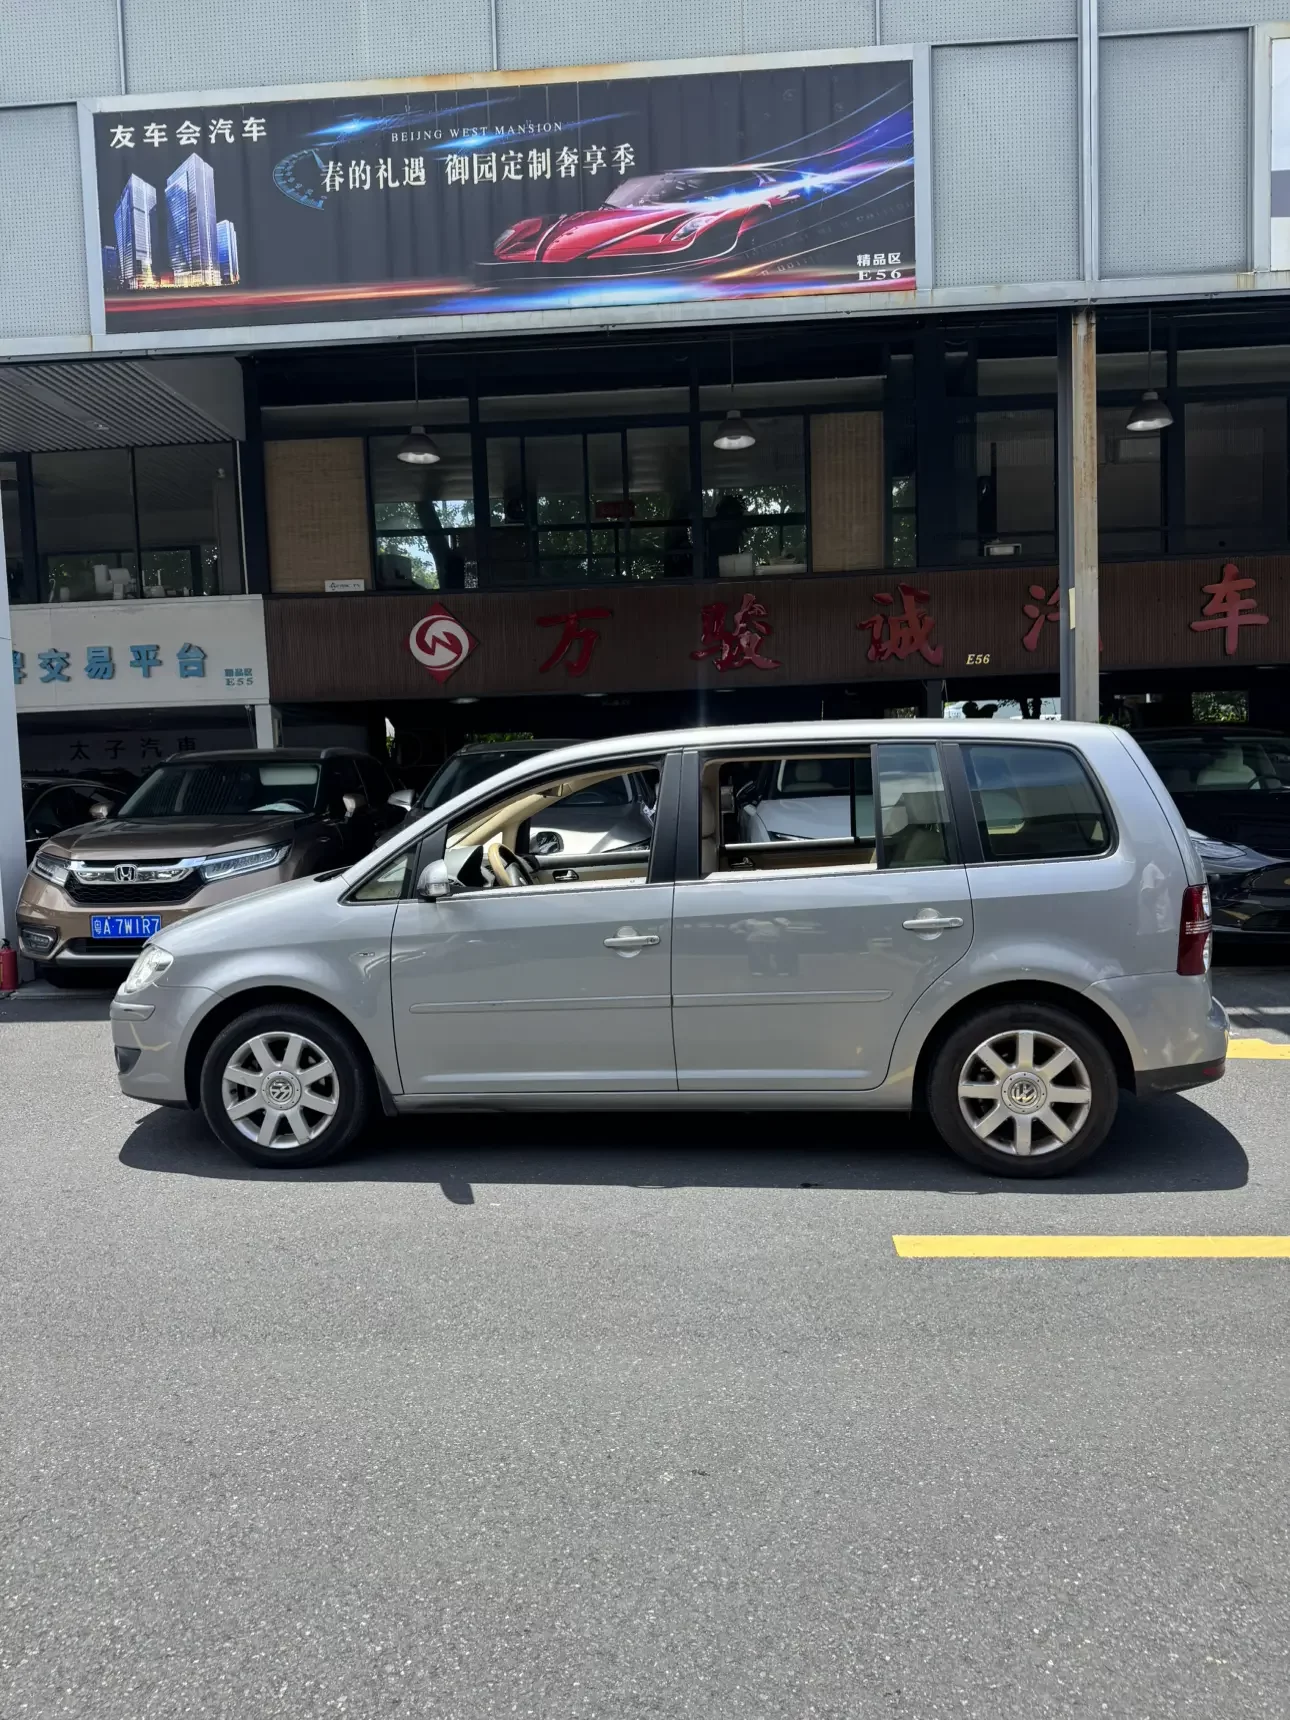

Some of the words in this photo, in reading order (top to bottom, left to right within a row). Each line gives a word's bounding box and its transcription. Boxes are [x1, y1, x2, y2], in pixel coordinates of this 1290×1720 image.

[109, 116, 268, 150] 友车会汽车
[449, 126, 488, 138] WEST
[494, 121, 563, 135] MANSION
[320, 155, 427, 193] 春的礼遇
[444, 143, 637, 186] 御园定制奢享季
[856, 252, 902, 267] 精品区
[857, 268, 902, 281] E56
[965, 653, 991, 665] E56
[225, 677, 254, 687] E55
